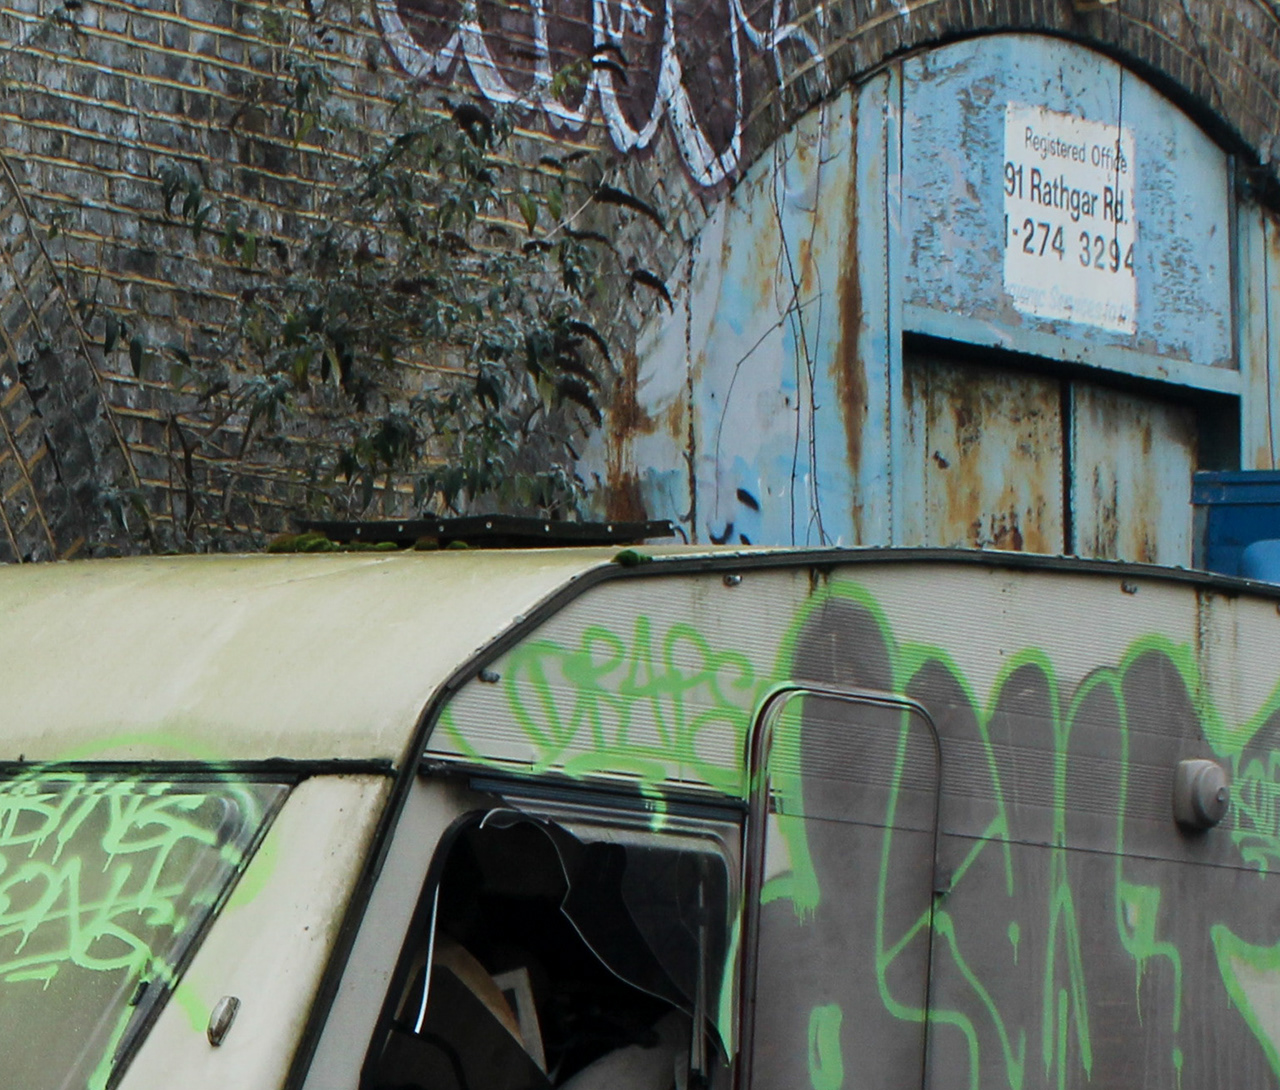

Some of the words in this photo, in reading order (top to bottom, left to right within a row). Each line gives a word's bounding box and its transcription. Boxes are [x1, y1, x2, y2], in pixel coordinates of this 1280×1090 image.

[1025, 126, 1086, 163] Registered
[1091, 144, 1128, 175] Office
[1003, 161, 1023, 199] 91
[1030, 167, 1098, 222] Rathgar
[1103, 185, 1128, 225] Rd.
